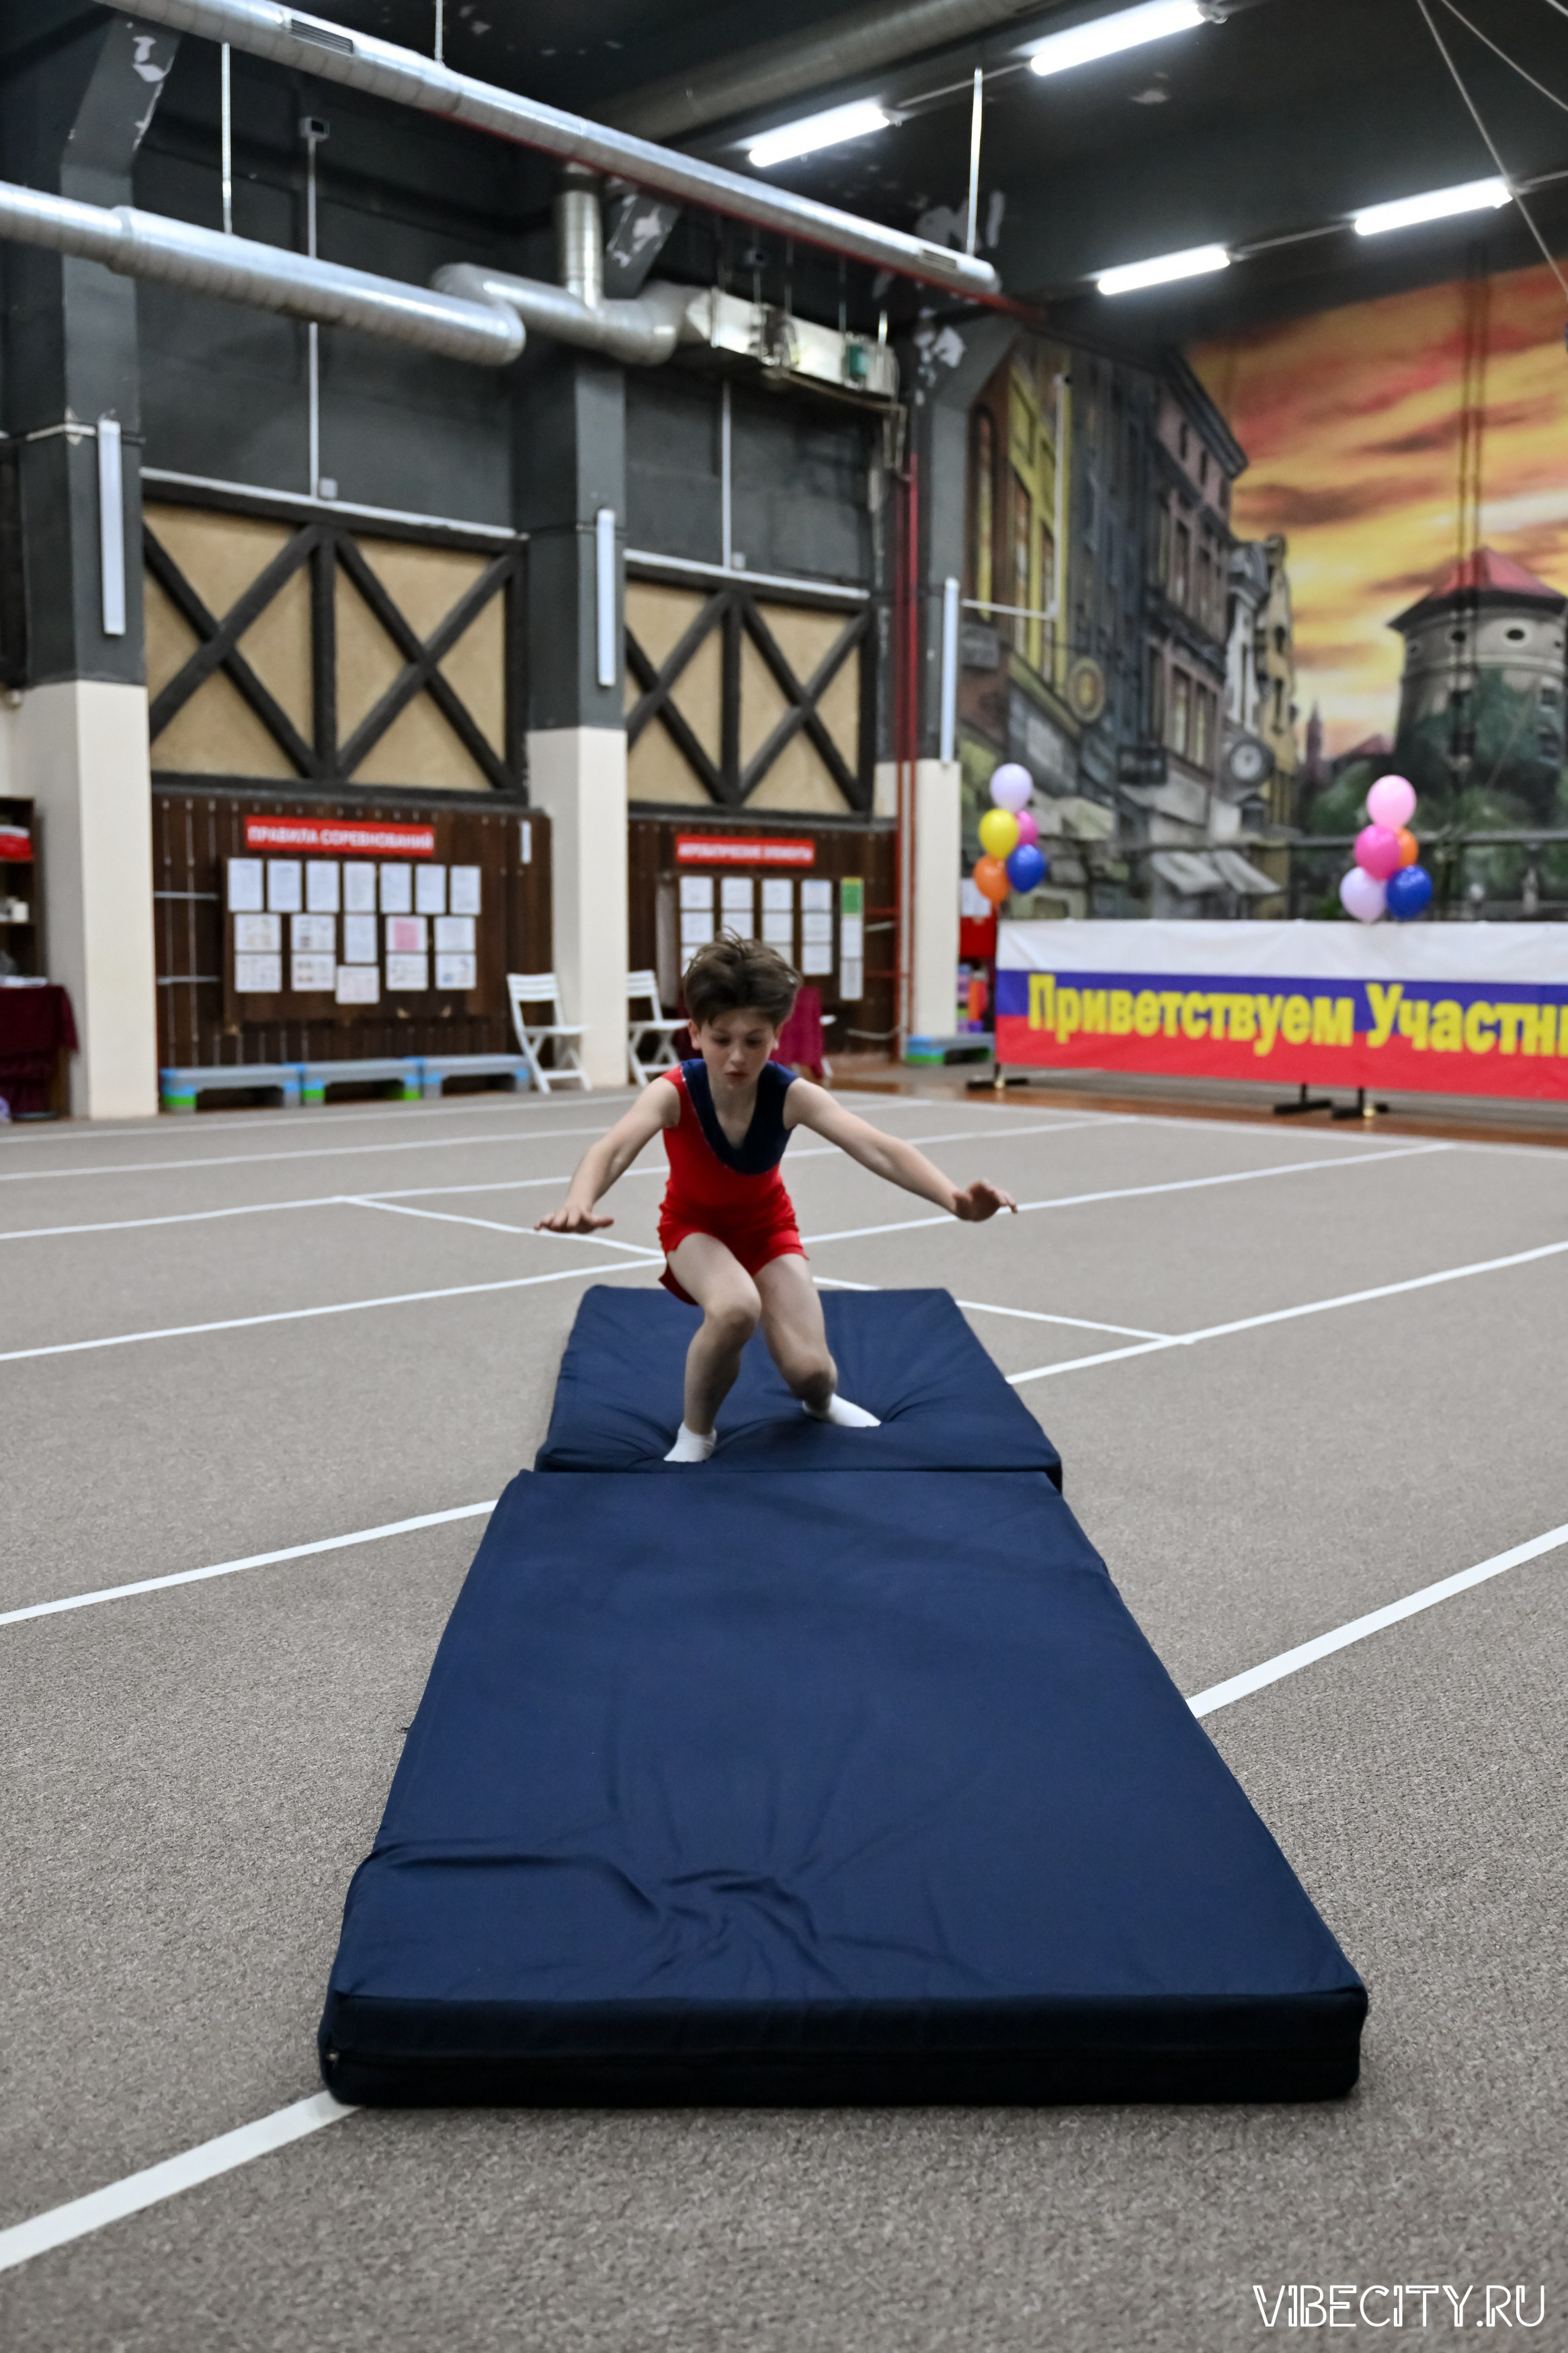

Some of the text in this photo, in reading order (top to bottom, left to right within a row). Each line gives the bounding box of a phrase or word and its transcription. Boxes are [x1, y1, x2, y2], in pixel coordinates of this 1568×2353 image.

[247, 826, 435, 850] ПРАВИЛА СОРЕВНОВАНИЙ
[1028, 973, 1568, 1059] Приветствуем Участн
